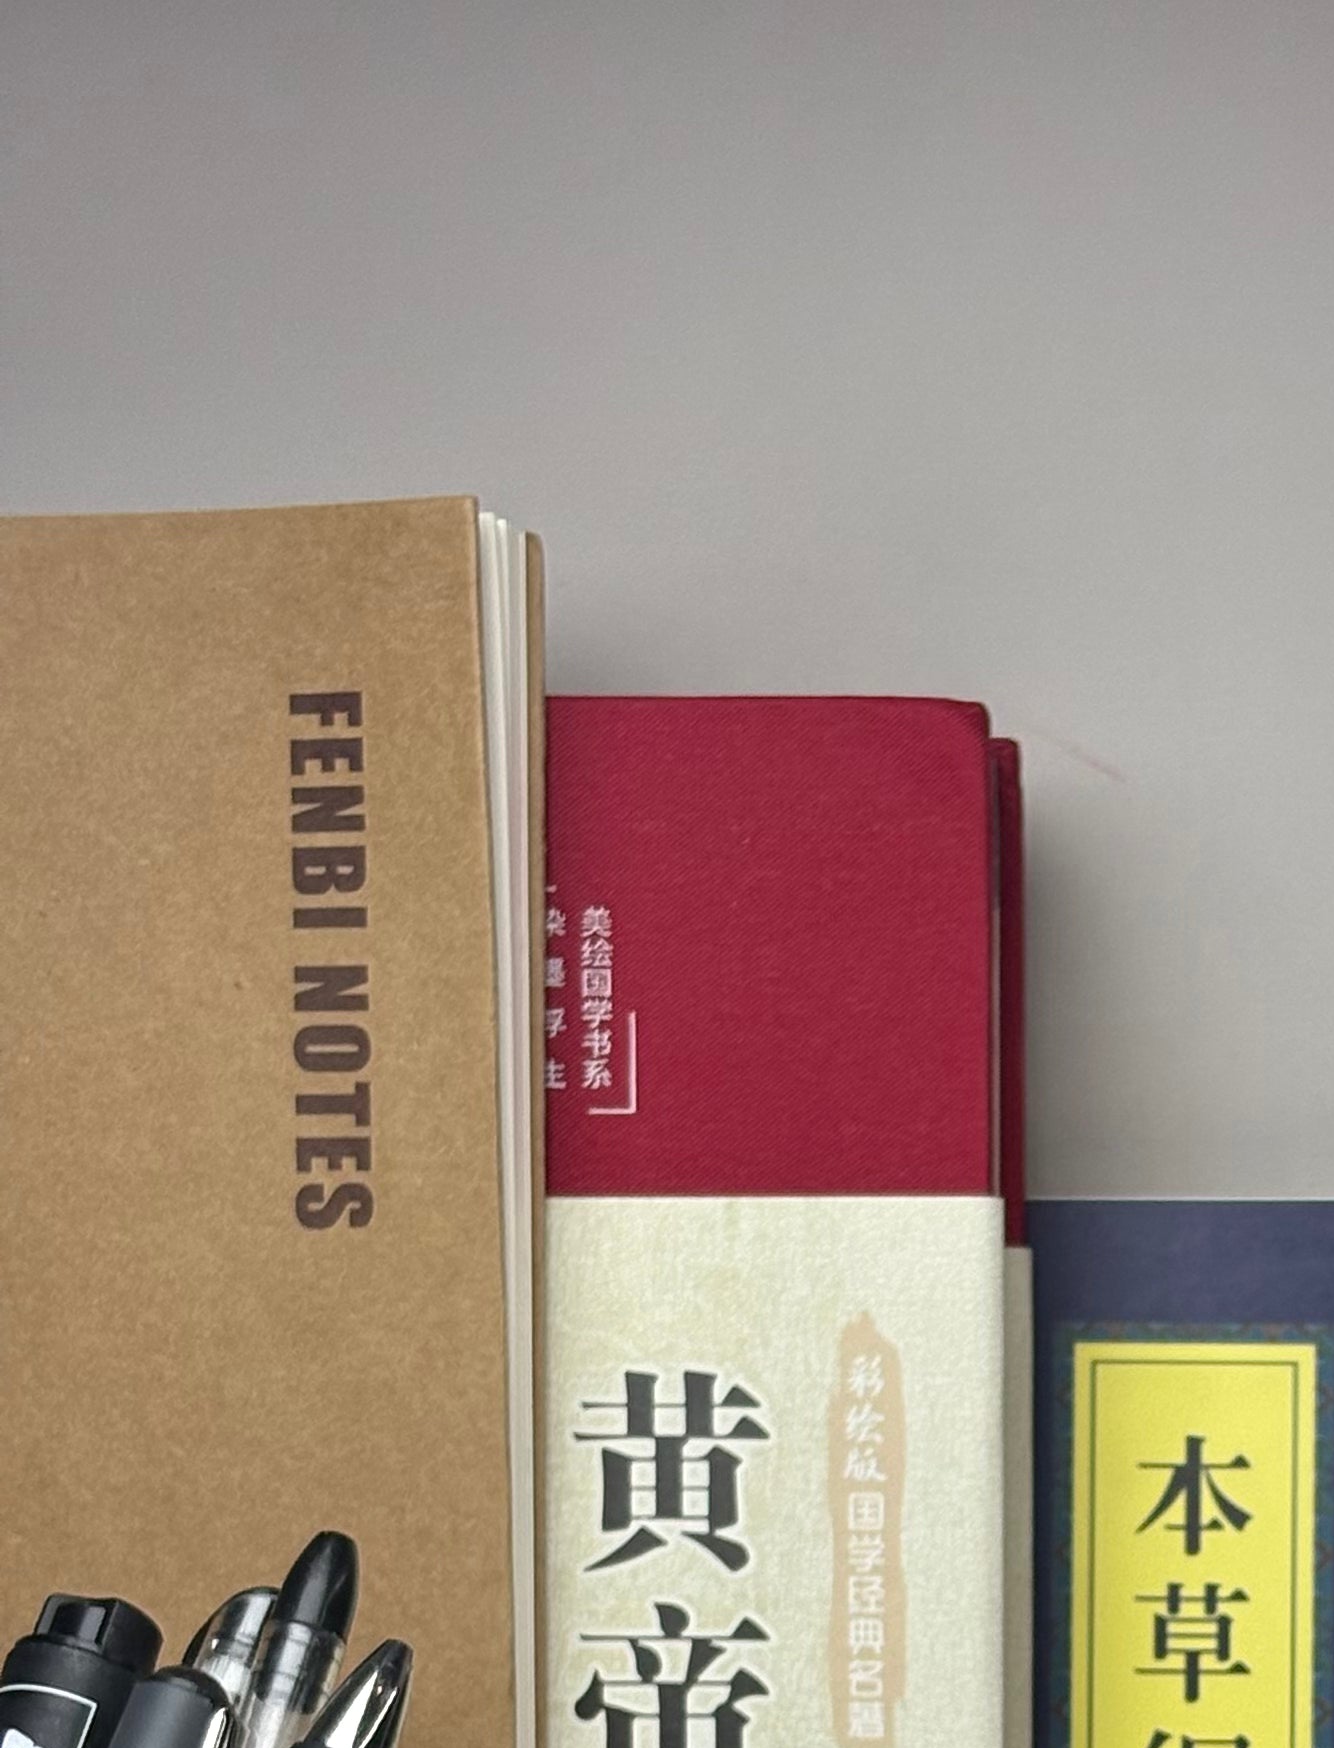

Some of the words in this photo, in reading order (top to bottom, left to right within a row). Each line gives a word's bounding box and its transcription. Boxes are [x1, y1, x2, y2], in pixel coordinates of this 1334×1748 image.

[289, 690, 367, 929] FENBI
[293, 965, 374, 1229] NOTES
[580, 905, 612, 1089] 美绘国学书系
